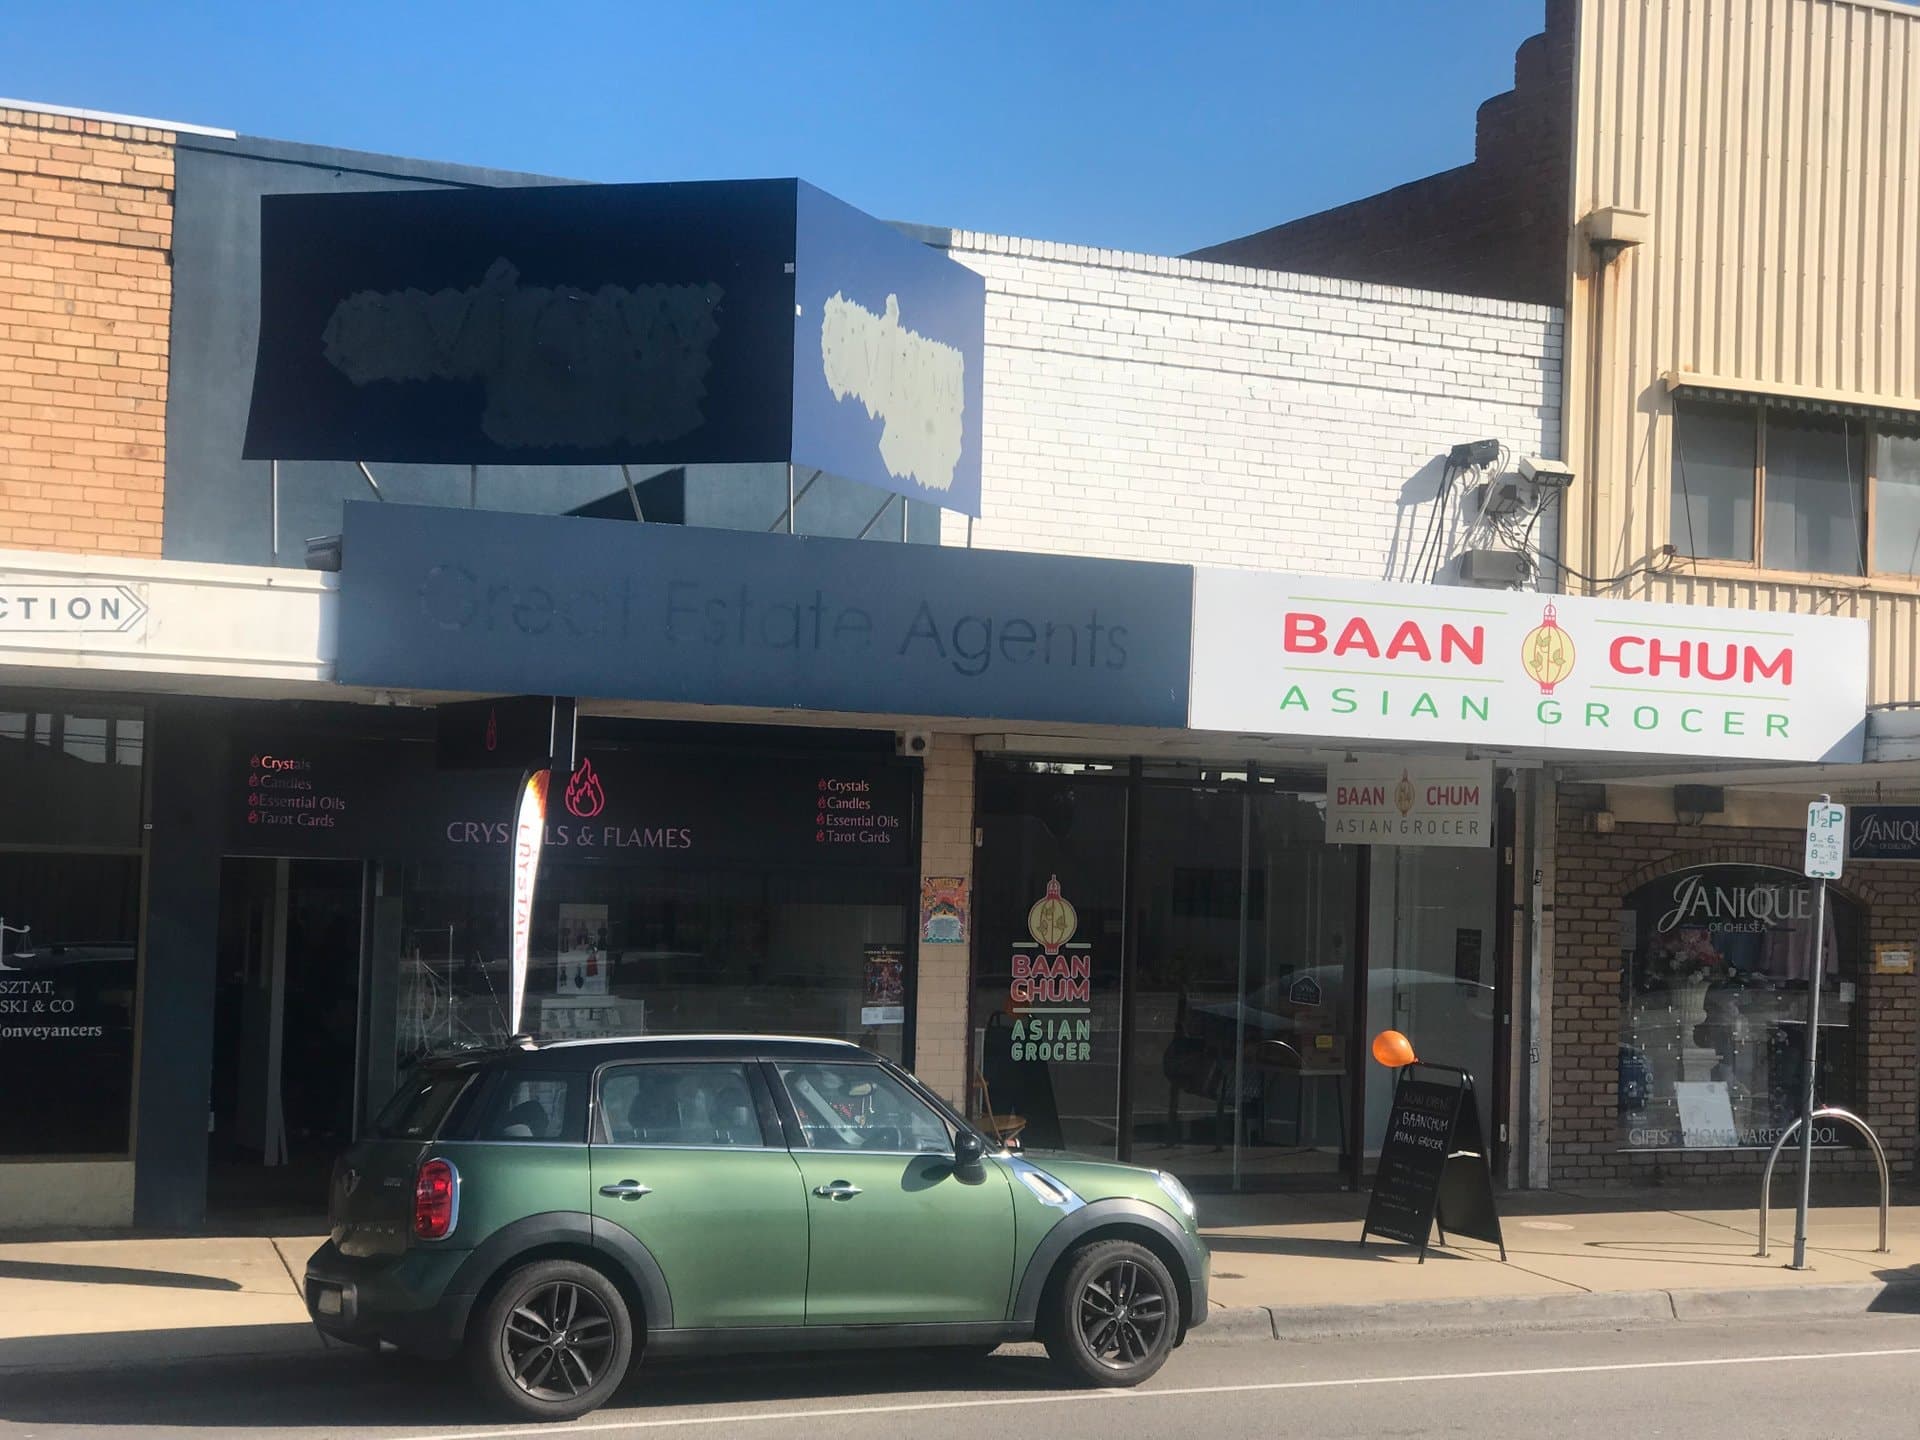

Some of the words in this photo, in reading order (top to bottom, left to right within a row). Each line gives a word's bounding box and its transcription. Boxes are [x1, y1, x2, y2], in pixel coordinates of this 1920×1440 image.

[897, 600, 1129, 677] Agents
[1284, 612, 1485, 666] BAAN
[1609, 636, 1793, 686] CHUM
[1280, 685, 1489, 721] ASIAN
[1537, 700, 1790, 738] GROCER
[261, 755, 312, 772] Crystals
[260, 774, 312, 790] Candles
[827, 779, 870, 794] Crystals
[259, 793, 316, 809] Essential
[319, 796, 346, 810] Oils
[826, 796, 871, 810] Candles
[1336, 786, 1385, 806] BAAN
[1426, 786, 1480, 806] CHUM
[259, 811, 294, 825] Tarot
[296, 813, 336, 827] Cards
[826, 814, 874, 828] Essential
[877, 815, 899, 828] Oils
[1336, 819, 1392, 834] ASIAN
[1401, 820, 1479, 835] GROCER
[446, 821, 569, 847] CRYSLS
[576, 826, 594, 846] &
[603, 826, 692, 849] FLAMES
[826, 830, 856, 843] Tarot
[859, 831, 891, 843] Cards
[1657, 873, 1812, 934] JANIQUE
[1012, 955, 1091, 978] BAAN
[1011, 978, 1090, 1002] CHUM
[32, 1000, 46, 1013] &
[49, 1000, 75, 1013] CO
[0, 1024, 102, 1041] onveyancers
[1011, 1019, 1090, 1041] ASIAN
[1011, 1042, 1091, 1061] GROCER
[1628, 1128, 1670, 1146] GIFTS
